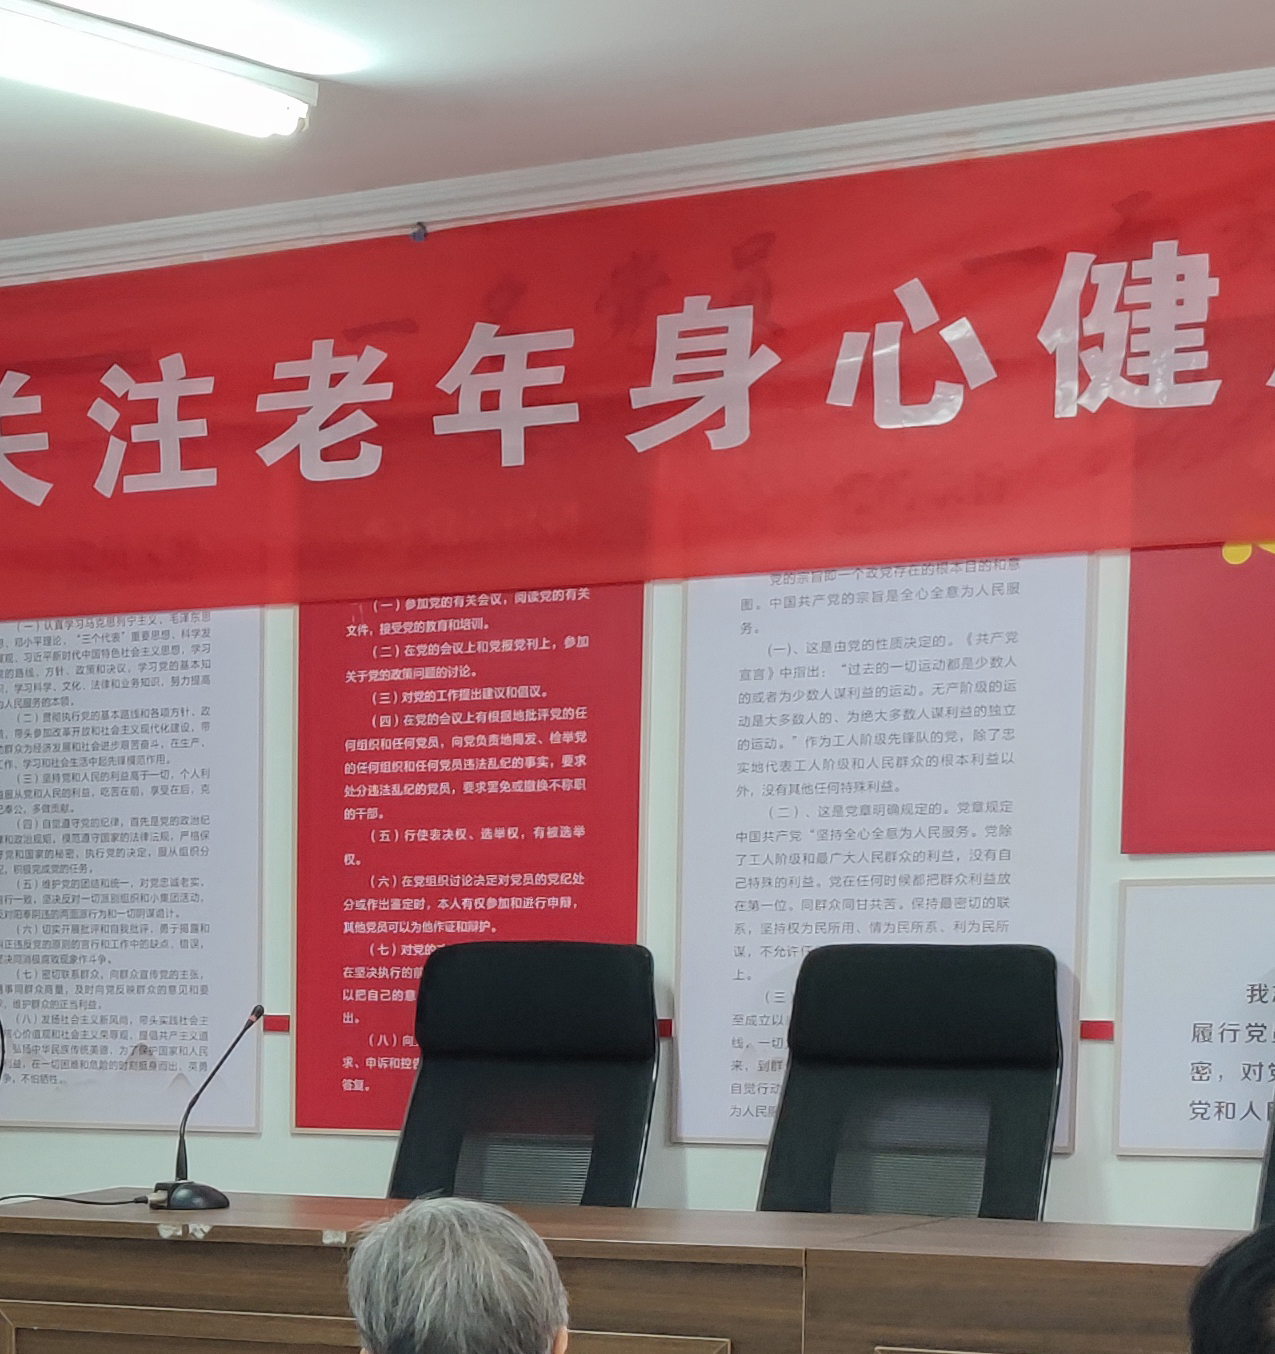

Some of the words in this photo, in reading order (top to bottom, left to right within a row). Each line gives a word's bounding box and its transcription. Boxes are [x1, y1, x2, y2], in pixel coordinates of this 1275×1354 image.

[373, 587, 590, 613] （一）参加党的有关会议，阅读党的有关
[740, 581, 1021, 612] 图。中国共产党的宗旨是全心全意为人民服
[346, 617, 489, 637] 文件，接受党的教育和培训。
[372, 635, 589, 659] （二）在党的会议上和党报党刊上，参加
[345, 665, 477, 684] 关于党的政策问题的讨论。
[372, 685, 548, 705] （三）对党的工作提出建议和倡议。
[738, 679, 1017, 705] 的或者为少数人谋利益的运动。无产阶级的运
[371, 706, 588, 728] （四）在党的会议上有根据地批评党的任
[736, 752, 1015, 774] 实地代表工人阶级和人民群众的根本利益以
[736, 779, 900, 798] 外，没有其他任何特殊利益。
[344, 807, 384, 820] 的干部。
[344, 854, 362, 866] 权。
[735, 848, 1011, 867] 了工人阶级和最广大人民群众的利益，没有自
[735, 872, 1011, 889] 己特殊的利益。党在任何时候都把群众利益放
[369, 943, 446, 957] （七）对党的
[1246, 983, 1275, 1004] 我
[1191, 1022, 1275, 1043] 履行党
